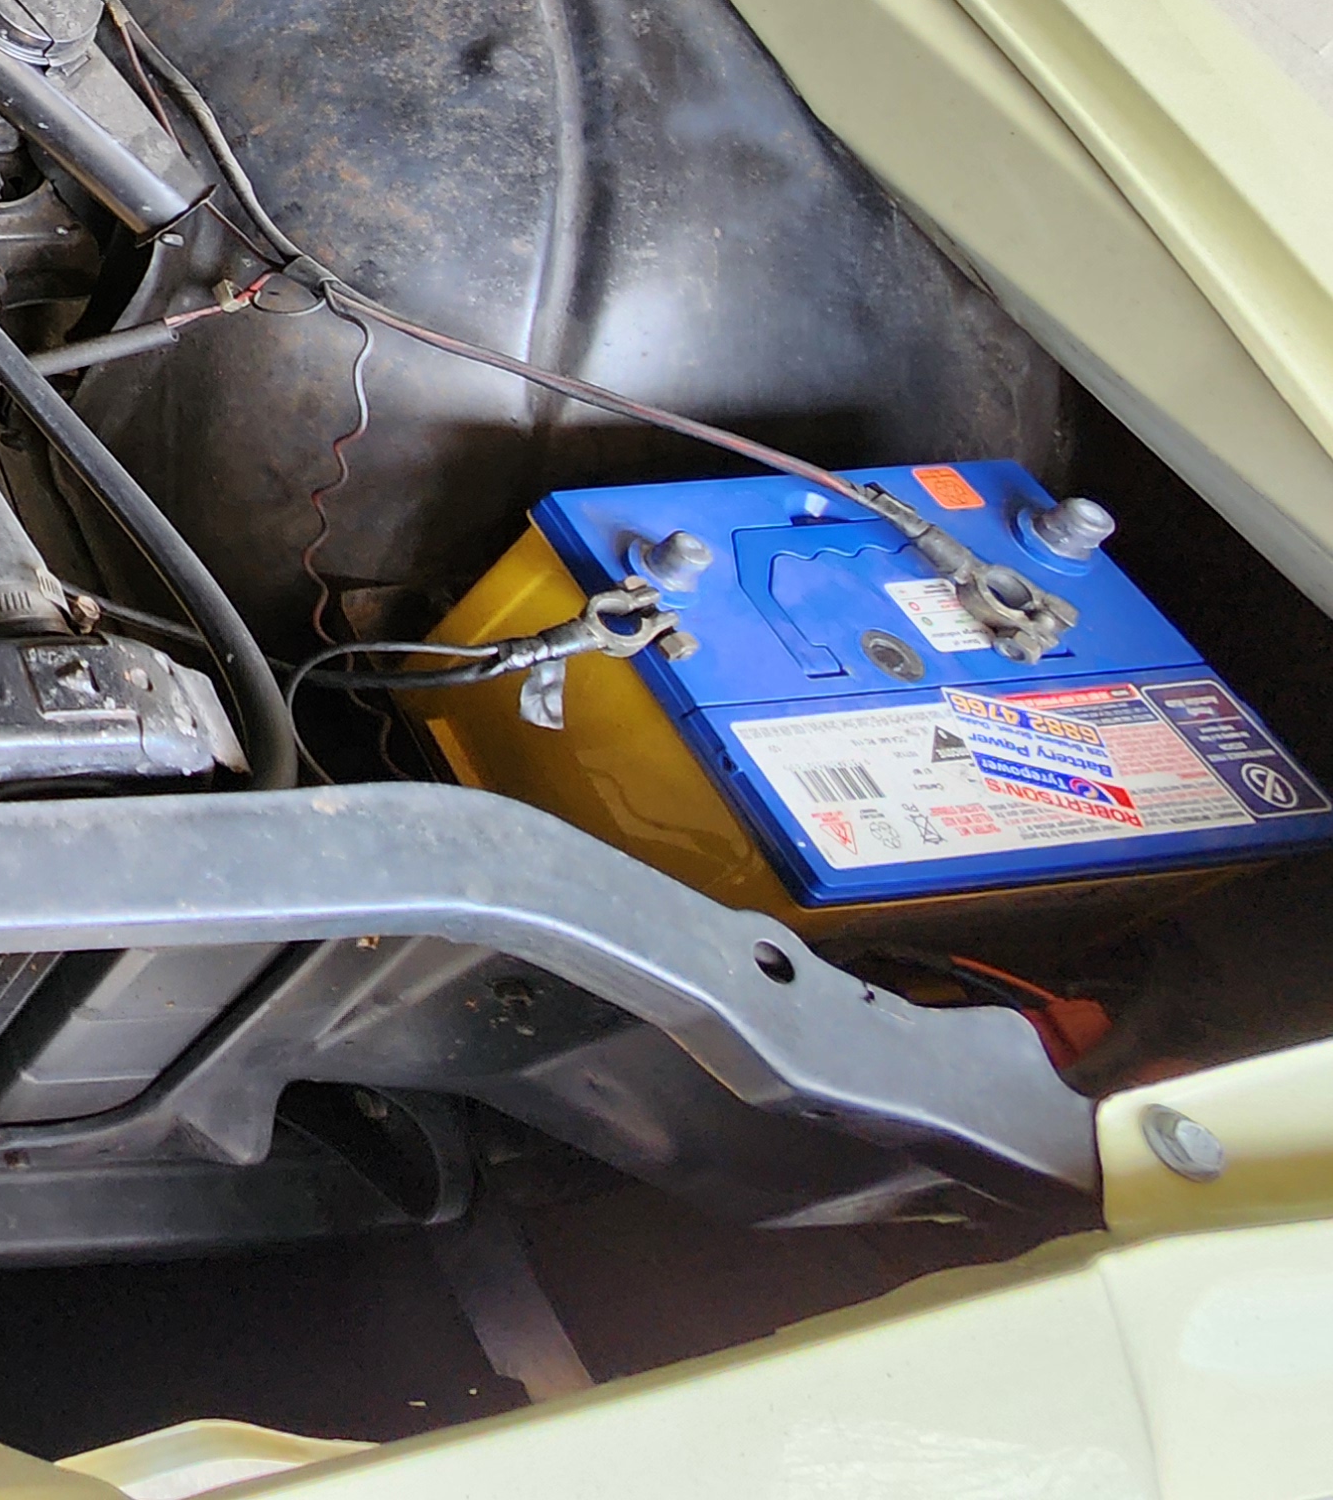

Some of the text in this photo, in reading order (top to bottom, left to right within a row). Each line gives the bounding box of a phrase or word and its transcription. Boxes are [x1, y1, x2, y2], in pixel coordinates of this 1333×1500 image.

[950, 694, 1020, 726] 4766
[1029, 713, 1101, 744] 6882
[1035, 734, 1085, 753] Brisbane
[968, 732, 1031, 758] Power
[981, 757, 1071, 791] Tyrepower
[1037, 745, 1114, 778] Battery
[984, 777, 1144, 828] ROBERTSON'S
